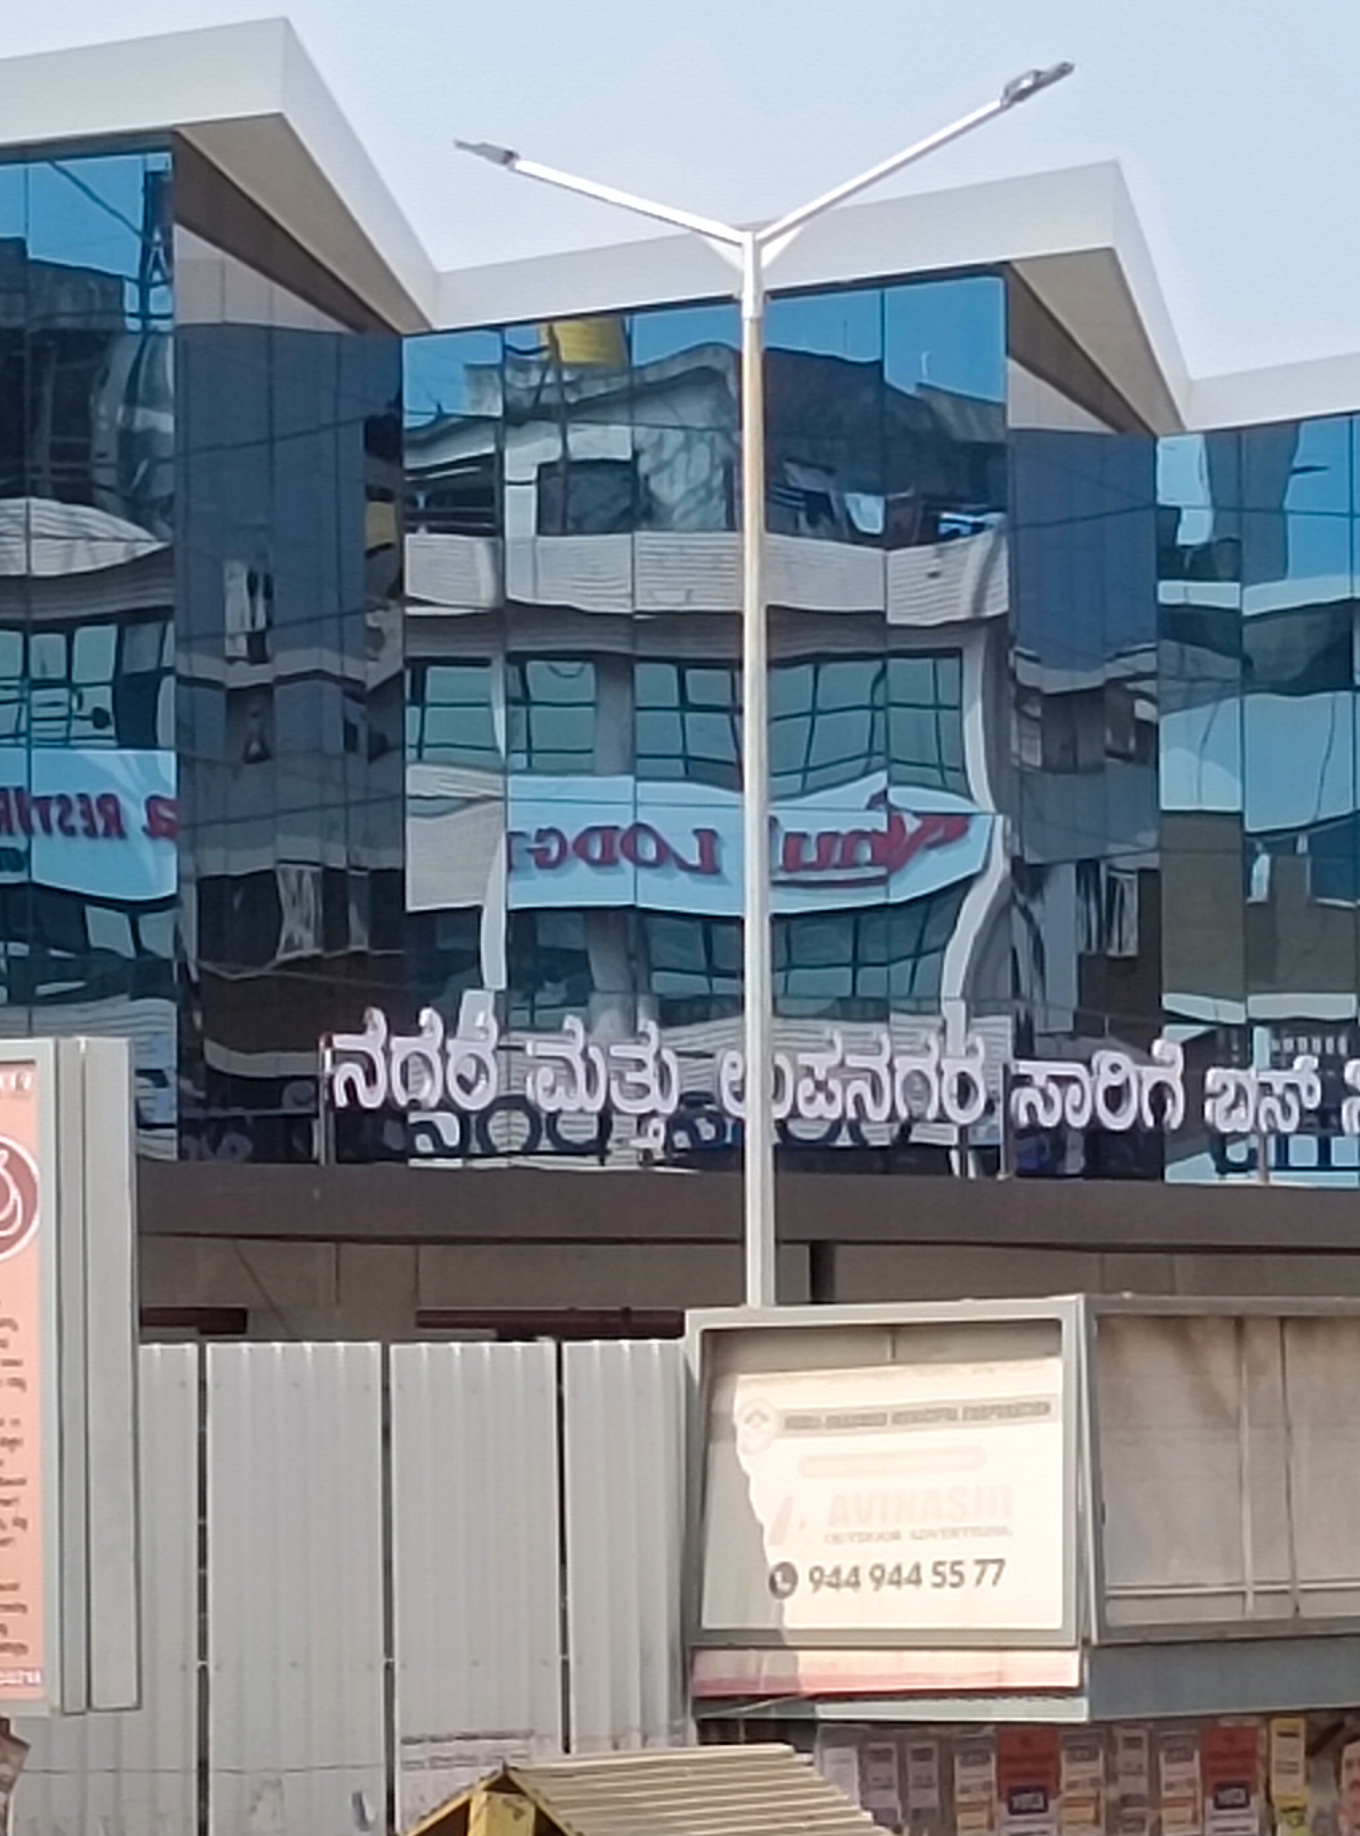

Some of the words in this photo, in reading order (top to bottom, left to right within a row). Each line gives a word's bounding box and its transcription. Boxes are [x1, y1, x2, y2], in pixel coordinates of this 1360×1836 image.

[526, 1014, 682, 1160] ಮತ್ತು
[1011, 1038, 1185, 1132] ಸಾರಿಗೆ
[1203, 1055, 1322, 1135] ಬಸ್
[827, 1484, 1014, 1528] AVINASHI
[807, 1564, 861, 1592] 944
[869, 1561, 924, 1590] 944
[930, 1560, 966, 1589] 55
[973, 1558, 1007, 1588] 77
